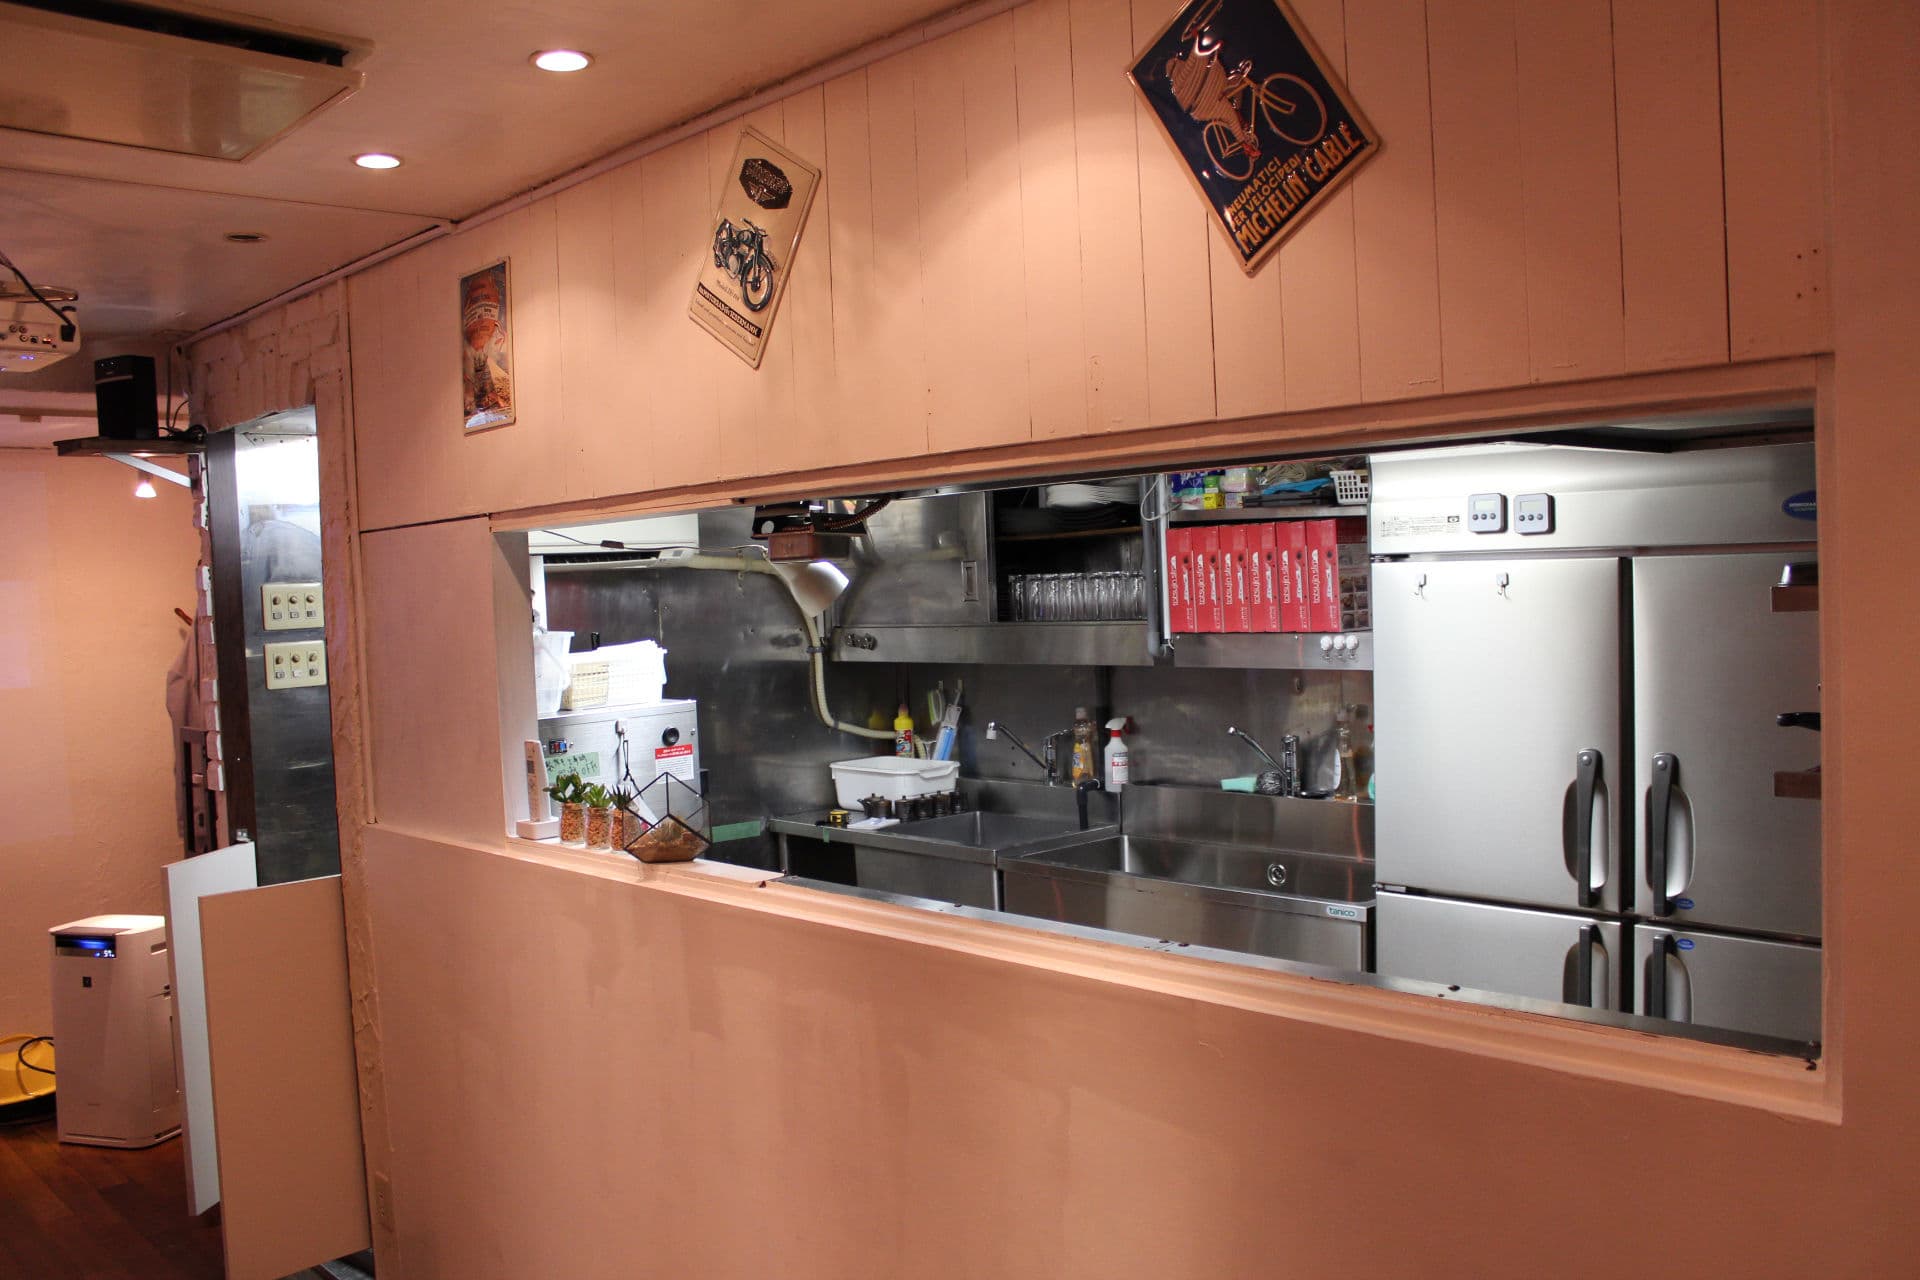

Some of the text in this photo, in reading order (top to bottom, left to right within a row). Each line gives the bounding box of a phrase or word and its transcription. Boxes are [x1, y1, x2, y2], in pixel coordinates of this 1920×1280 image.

[1224, 156, 1281, 219] NEUMATICI
[1235, 171, 1311, 255] MICHELIN
[1245, 153, 1302, 212] VELOCIPEDI
[1329, 907, 1356, 917] tanico
